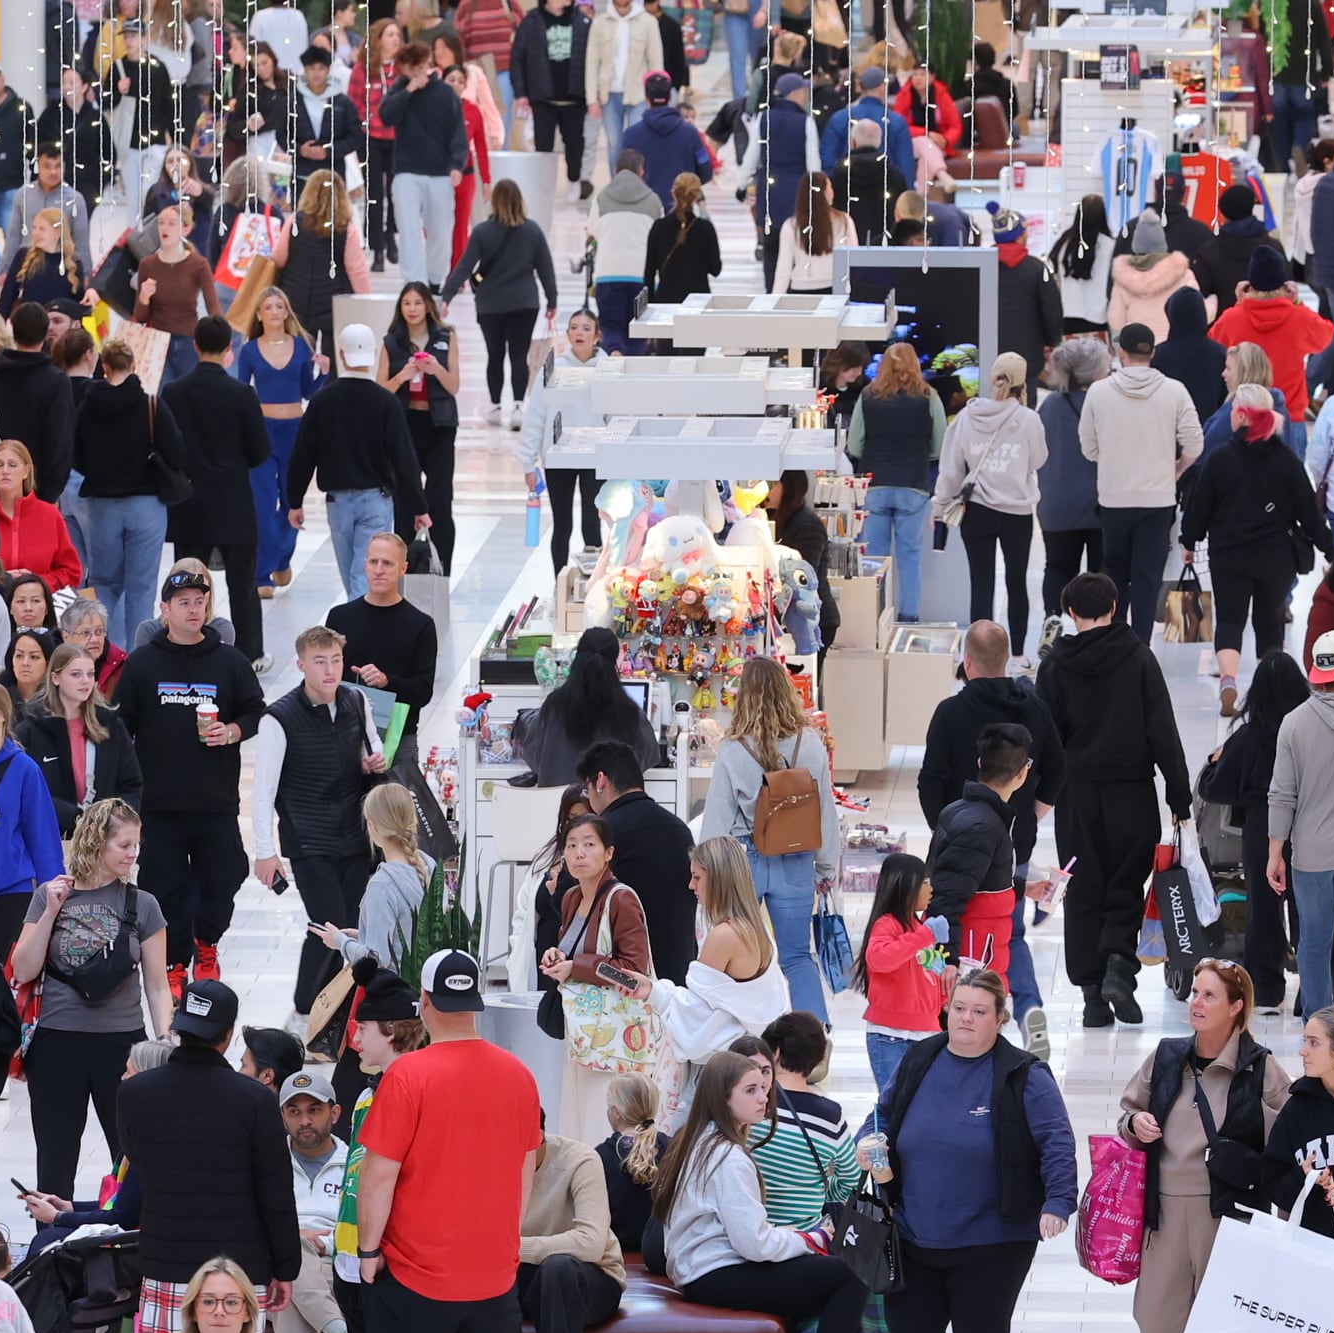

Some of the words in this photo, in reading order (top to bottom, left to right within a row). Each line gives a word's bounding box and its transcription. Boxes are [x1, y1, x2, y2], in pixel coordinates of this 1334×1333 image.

[160, 694, 214, 706] patagonia
[1101, 1208, 1142, 1229] holiday
[1232, 1294, 1260, 1315] THE
[1259, 1306, 1307, 1333] SUPER
